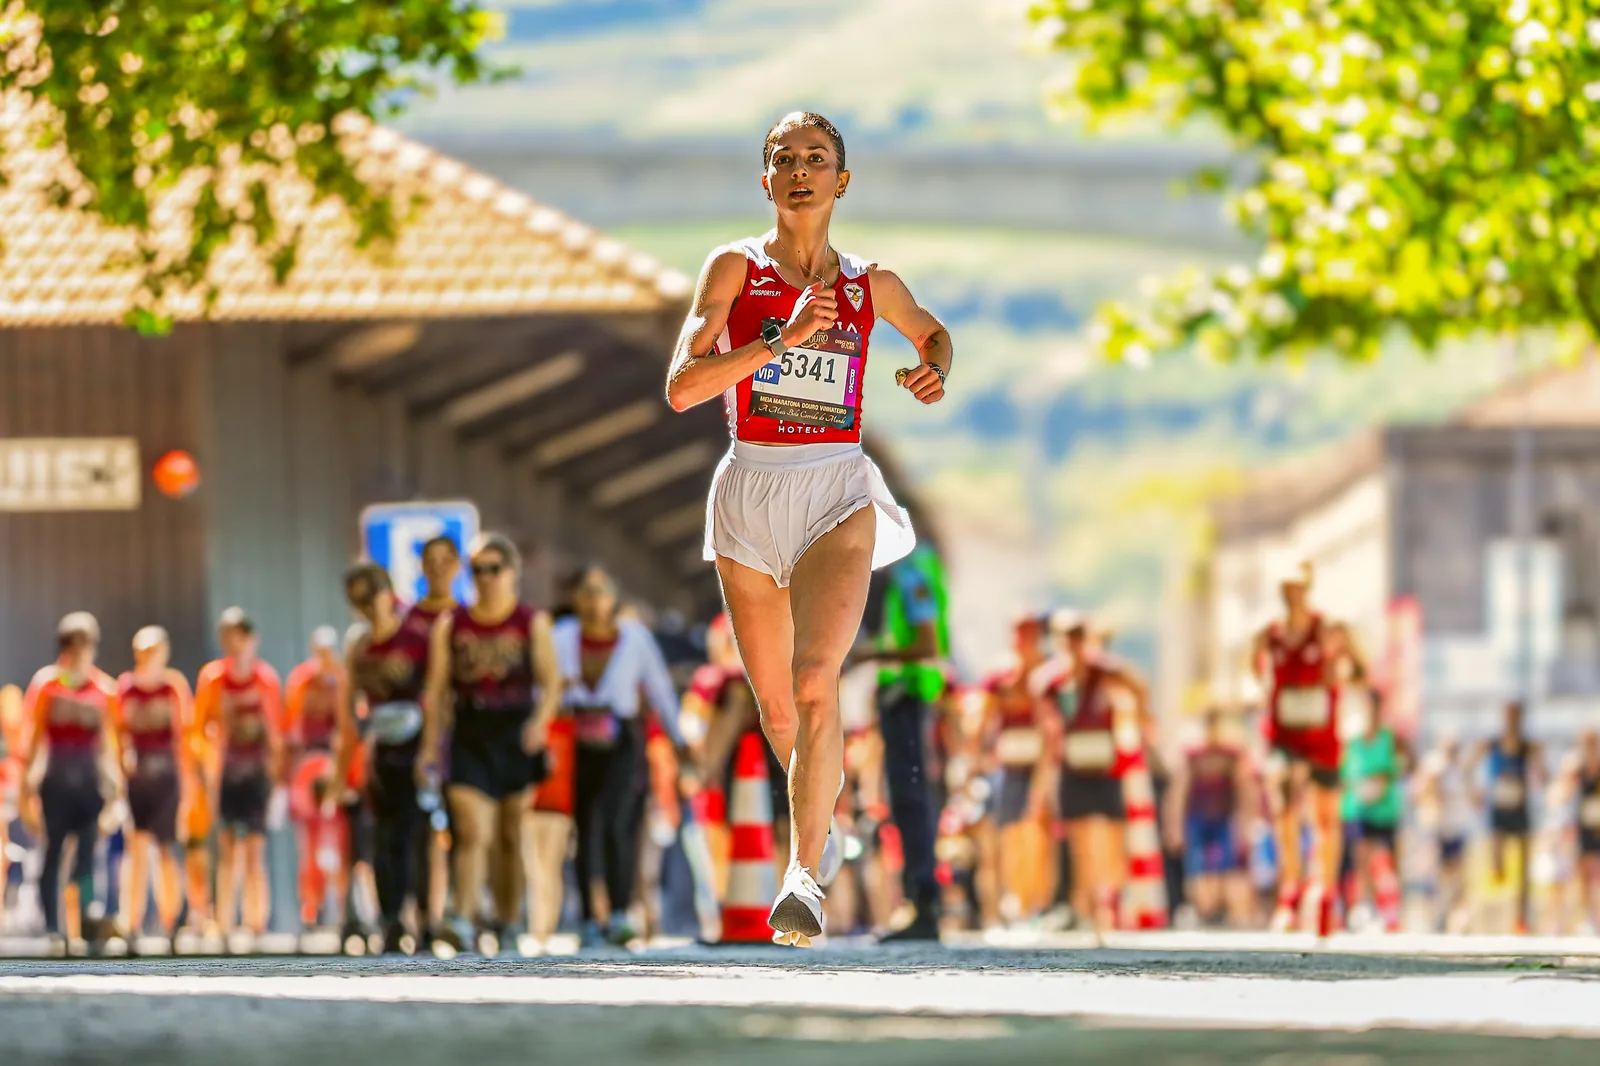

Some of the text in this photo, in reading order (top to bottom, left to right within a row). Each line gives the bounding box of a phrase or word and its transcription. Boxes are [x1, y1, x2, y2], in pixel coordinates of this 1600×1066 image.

[808, 334, 829, 343] OURO
[758, 368, 774, 380] VIP
[780, 351, 835, 383] 5341
[848, 368, 856, 393] BUS
[760, 395, 773, 403] MEIA
[773, 398, 800, 408] MARATONA
[801, 402, 819, 411] DOURO
